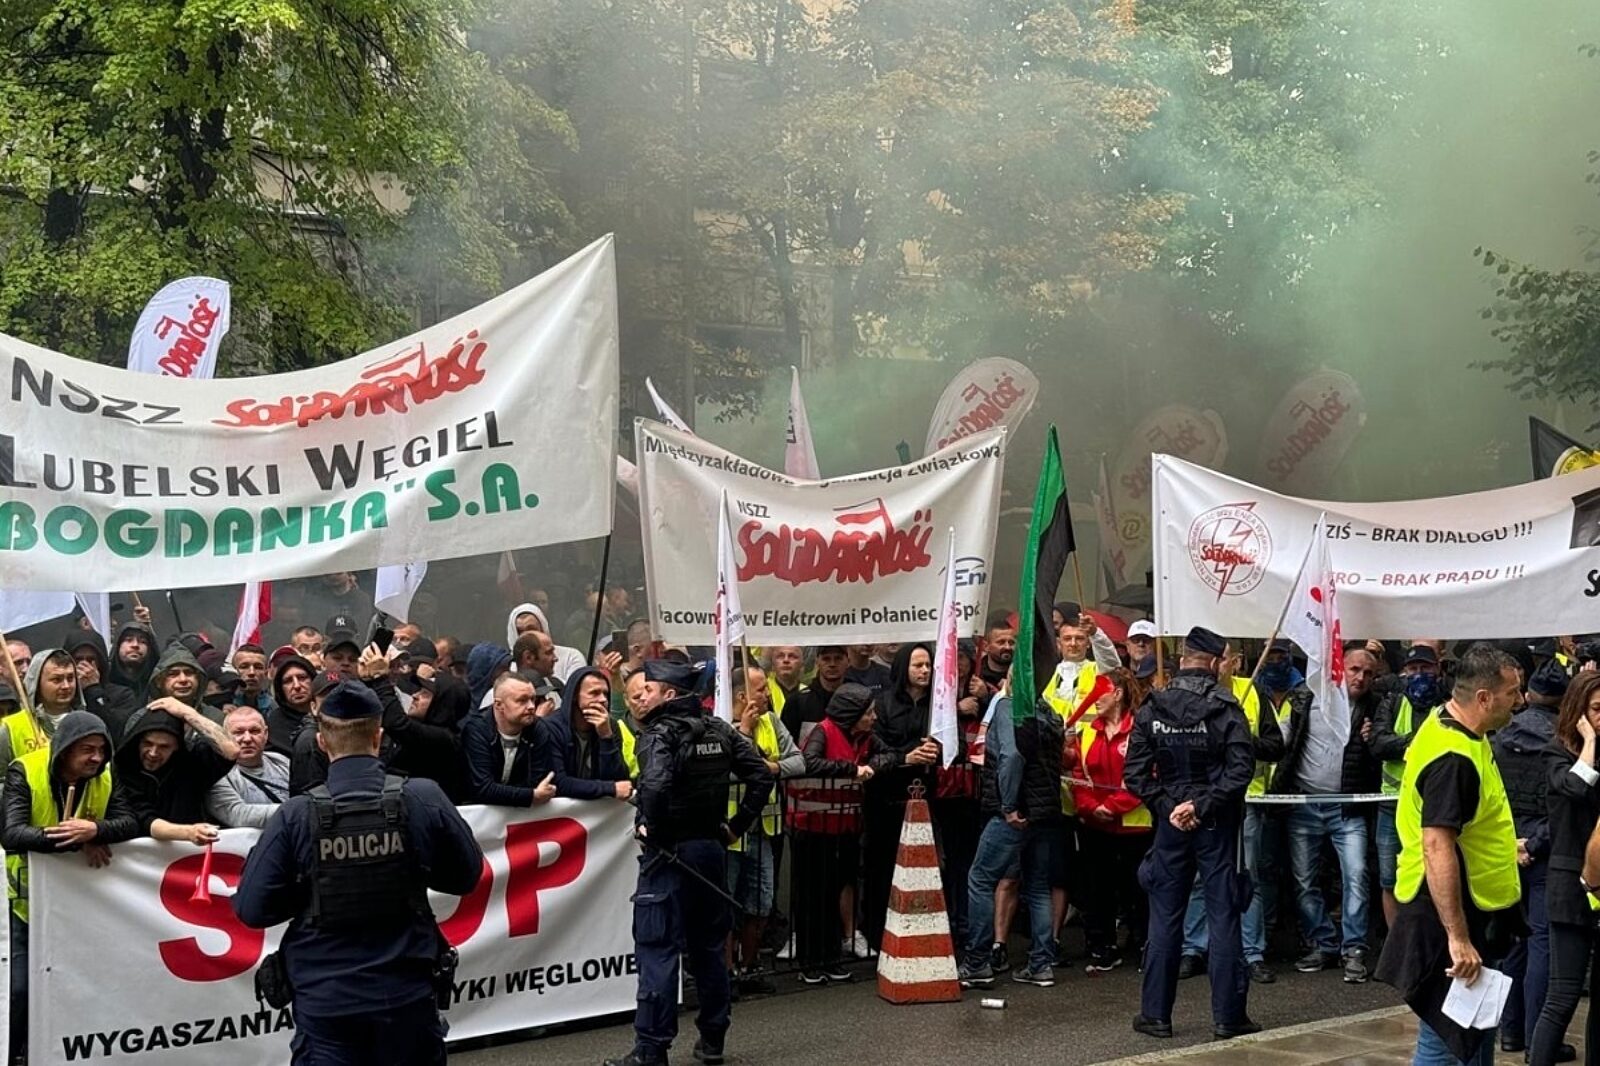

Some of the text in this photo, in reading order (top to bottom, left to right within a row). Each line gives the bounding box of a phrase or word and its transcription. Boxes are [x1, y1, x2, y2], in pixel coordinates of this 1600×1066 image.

[11, 356, 184, 424] NSZZ
[303, 410, 514, 491] WĘGIEL
[424, 461, 540, 522] S.A.
[1313, 521, 1351, 541] ZIŚ
[1371, 527, 1420, 544] BRAK
[1425, 526, 1508, 544] DIALOGU
[1381, 572, 1430, 587] BRAK
[1434, 568, 1499, 585] PRĄDU
[762, 607, 856, 628] Elektrowni
[860, 605, 938, 625] Połaniec
[319, 831, 405, 861] POLICJA
[450, 975, 497, 1005] YKI
